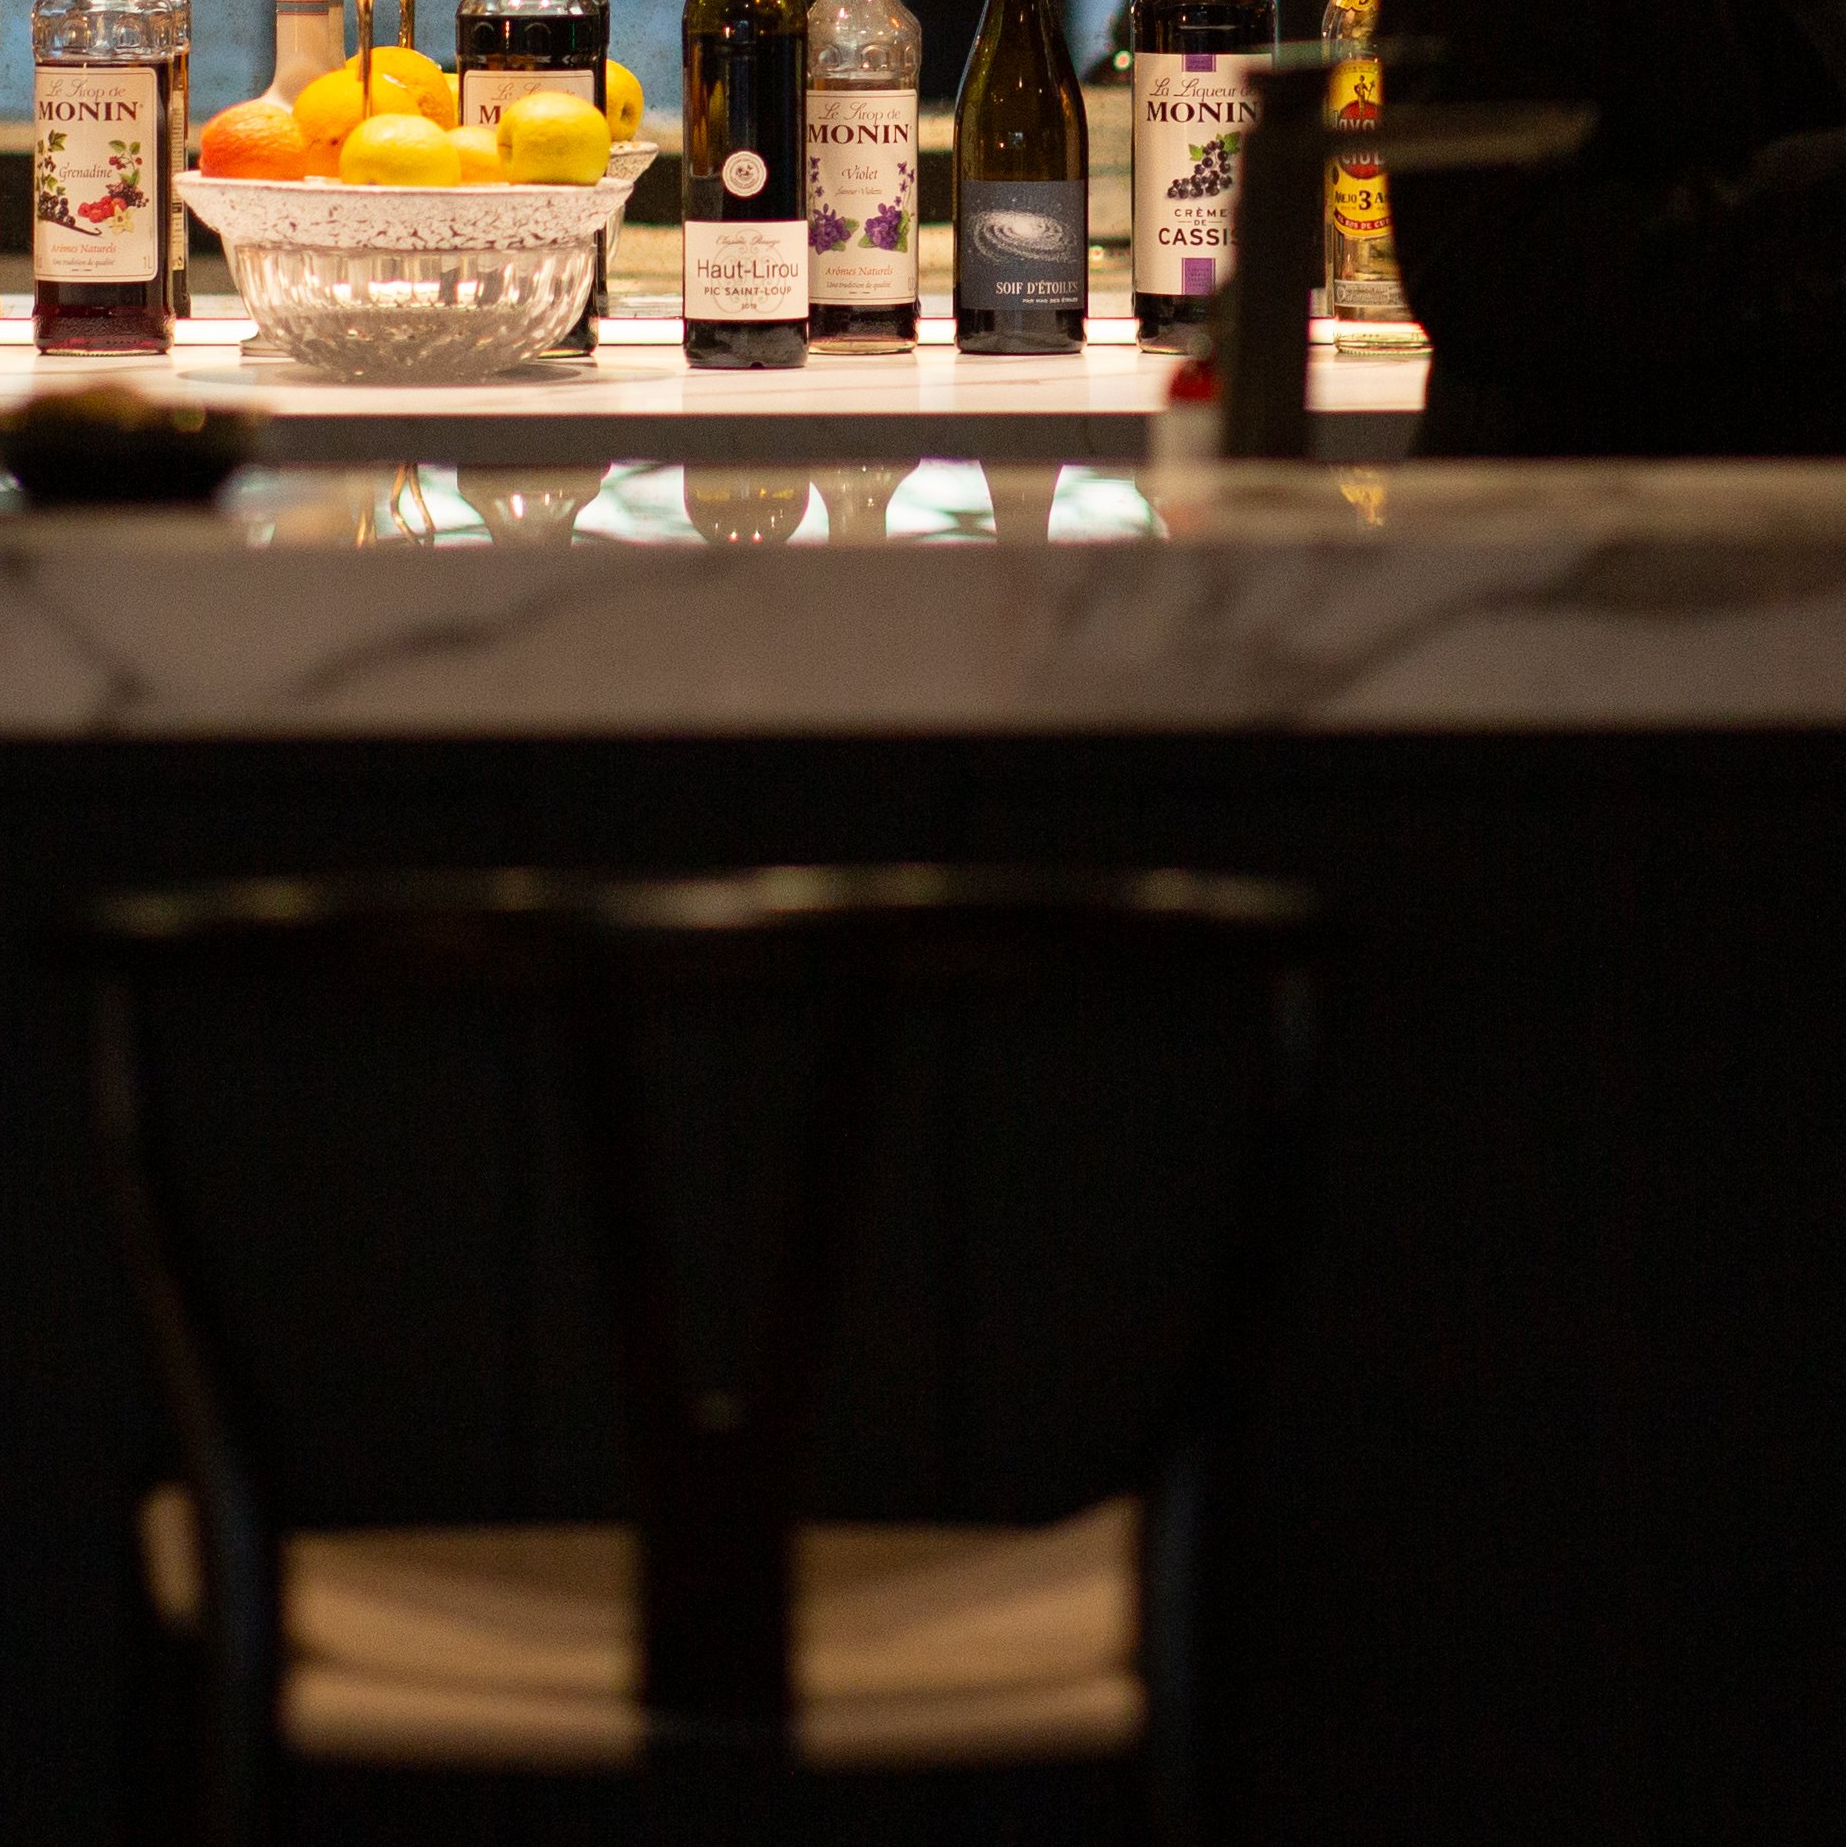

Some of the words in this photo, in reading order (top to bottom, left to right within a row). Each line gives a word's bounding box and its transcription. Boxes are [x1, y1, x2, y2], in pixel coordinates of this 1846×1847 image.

[46, 78, 63, 97] Le
[65, 77, 106, 103] Sirop
[109, 85, 126, 97] de
[1149, 76, 1171, 98] La
[1172, 77, 1237, 104] Liqueur
[38, 101, 138, 122] MONIN
[818, 102, 839, 120] Le
[843, 101, 884, 124] Sirop
[887, 108, 901, 120] de
[1145, 100, 1258, 124] MONIN
[808, 124, 909, 145] MONIN
[58, 161, 114, 183] Grenadine
[841, 164, 878, 181] Violet
[1358, 189, 1372, 211] 3
[1173, 206, 1228, 219] CRÈME
[1193, 218, 1208, 227] DE
[50, 244, 79, 254] Arômes
[80, 244, 117, 254] Naturels
[697, 258, 799, 280] Haut-Lirou
[825, 265, 856, 276] Arômes
[858, 265, 893, 276] Naturels
[704, 286, 721, 296] PIC
[724, 285, 792, 296] SAINT-LOUP
[995, 281, 1024, 295] SOIF
